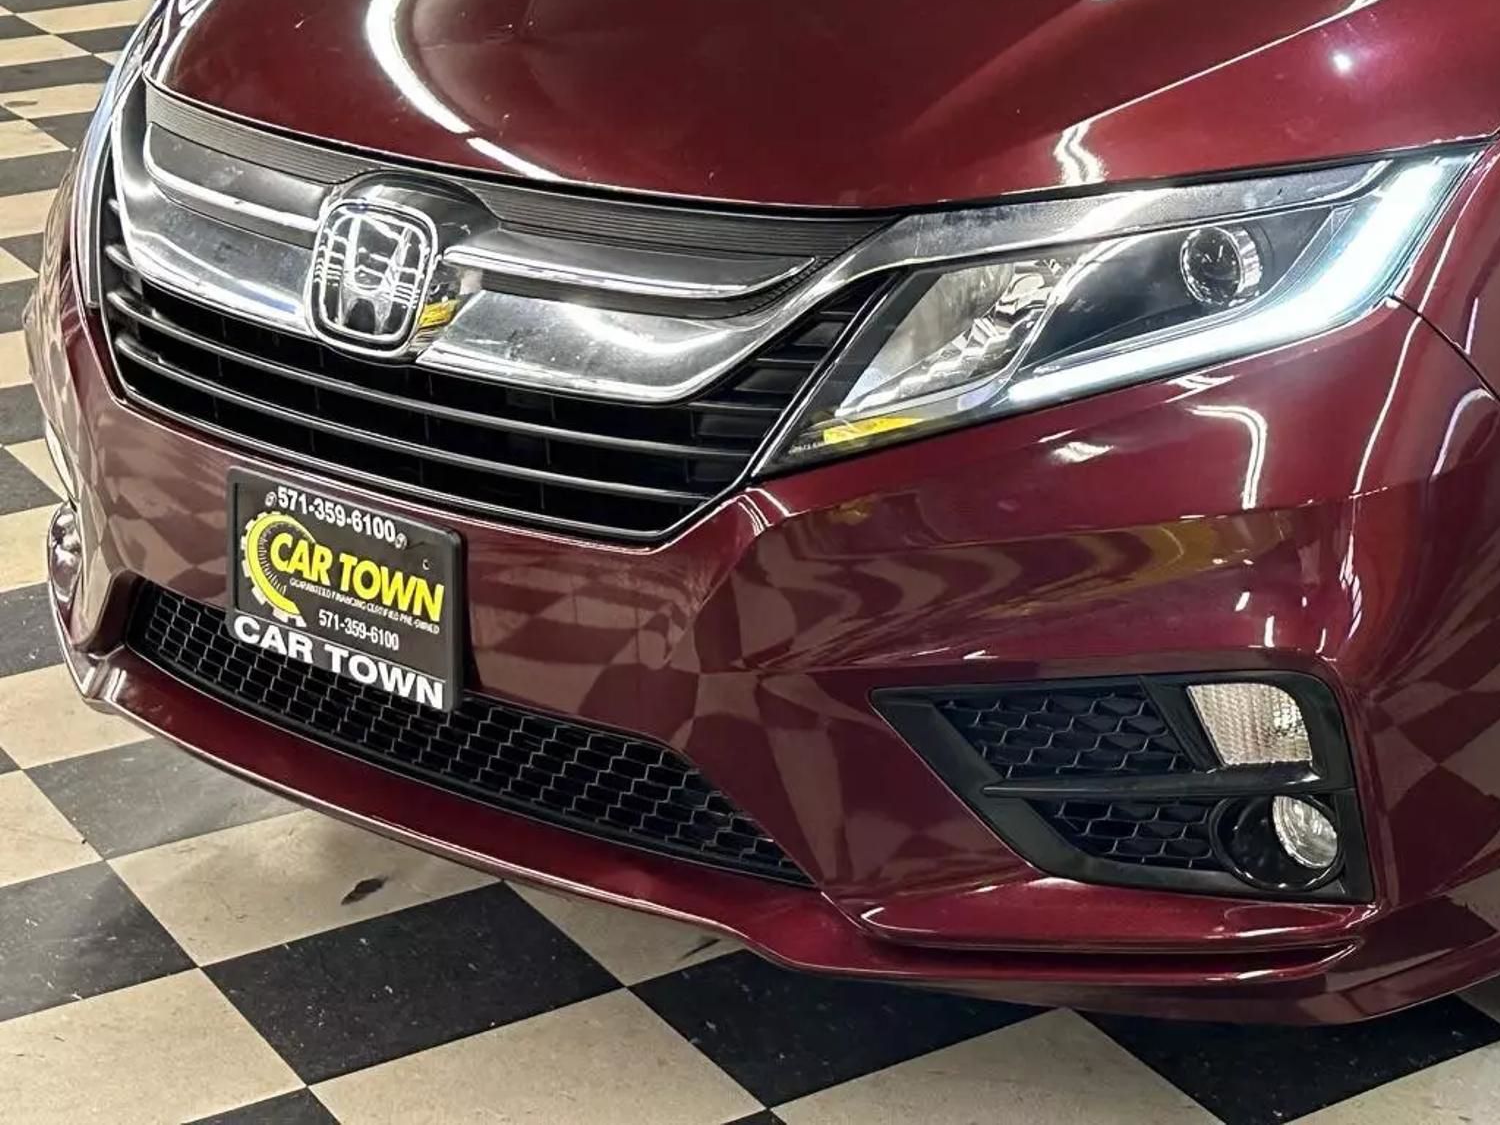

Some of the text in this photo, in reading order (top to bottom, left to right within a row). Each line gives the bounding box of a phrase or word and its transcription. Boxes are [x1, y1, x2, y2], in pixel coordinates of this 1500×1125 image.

[277, 485, 397, 543] 571-359-6100
[270, 532, 445, 622] CAR TOWN
[233, 615, 443, 710] CAR TOWN
[318, 609, 399, 651] 571-359-6100
